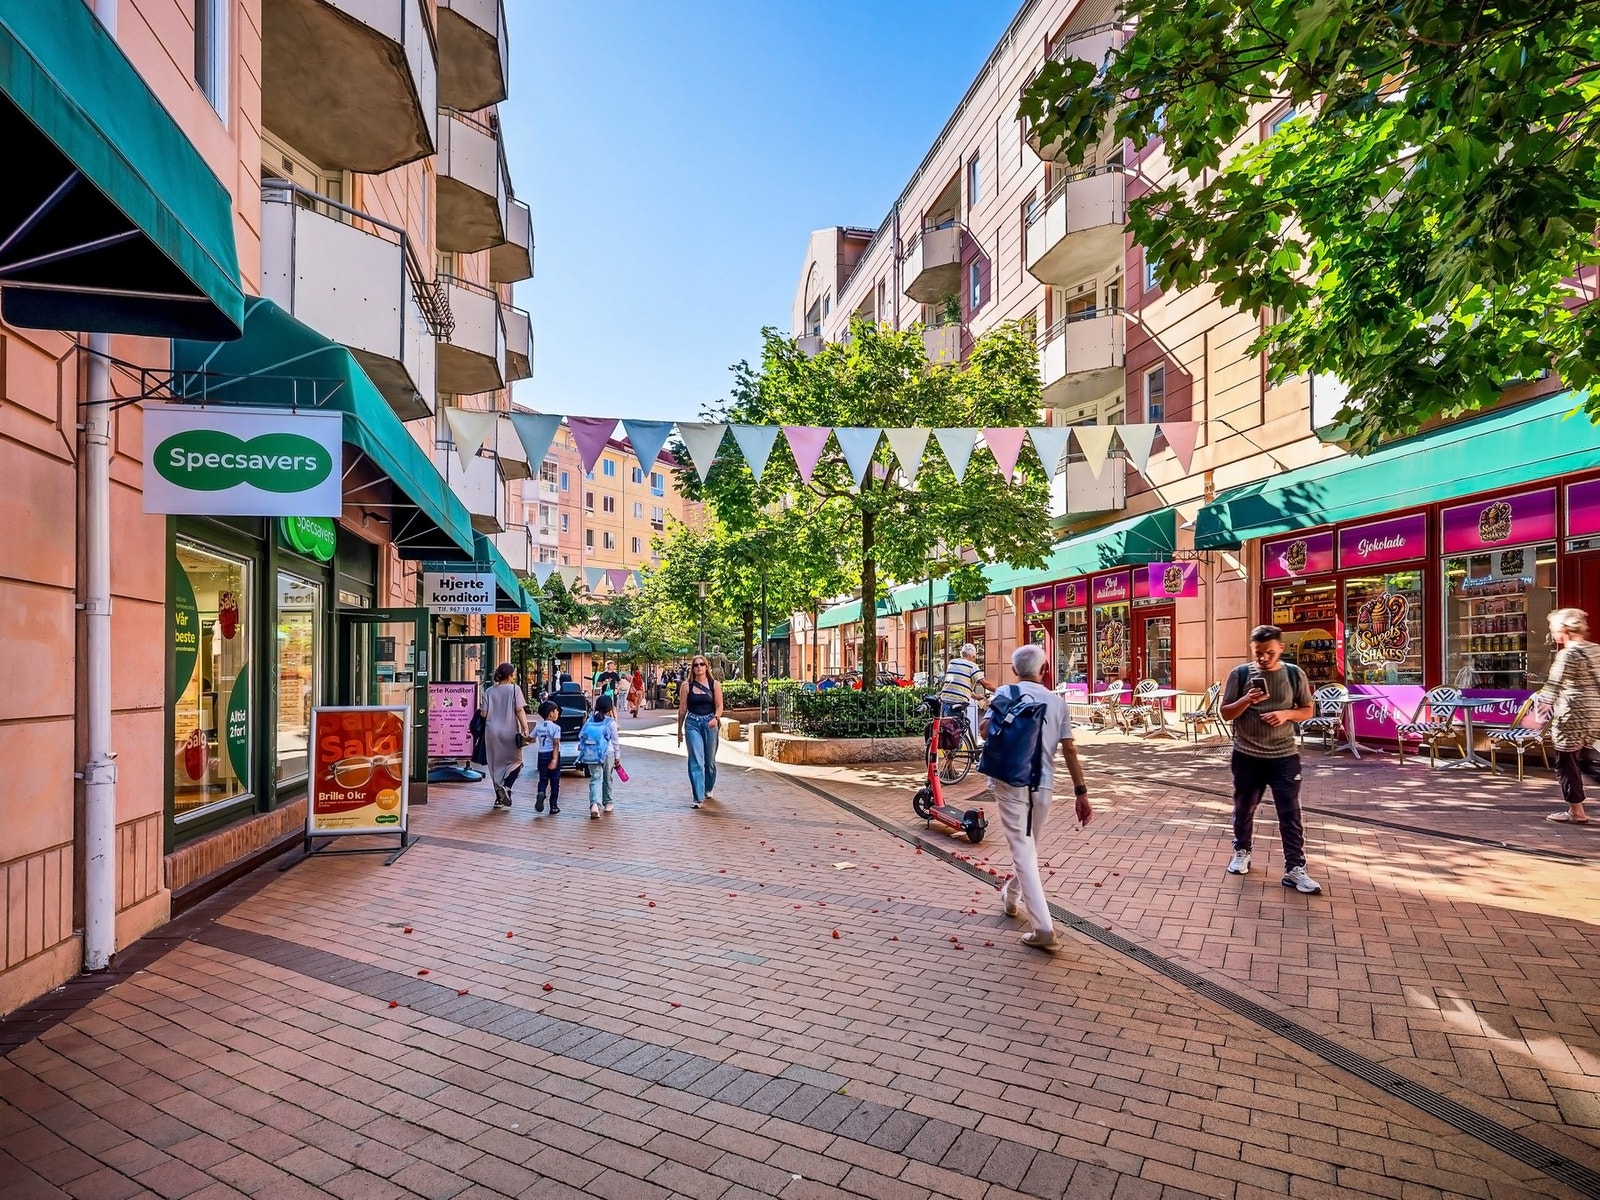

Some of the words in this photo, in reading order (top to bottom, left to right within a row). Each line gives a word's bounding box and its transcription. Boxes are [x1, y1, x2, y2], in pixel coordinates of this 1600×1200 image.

[170, 447, 317, 472] Specsavers
[297, 516, 335, 545] Specsavers
[1357, 533, 1407, 558] Sjokolade
[440, 577, 484, 590] Hjerte
[432, 591, 489, 603] konditori
[175, 611, 189, 626] Vår
[498, 614, 520, 624] Pele
[498, 623, 520, 633] Pele
[175, 629, 196, 644] beste
[1359, 625, 1401, 651] Sweets
[1362, 648, 1403, 663] SHAKES
[444, 686, 474, 694] Konditori
[230, 709, 246, 723] Alltid
[540, 735, 547, 747] 7
[318, 791, 345, 801] Brille
